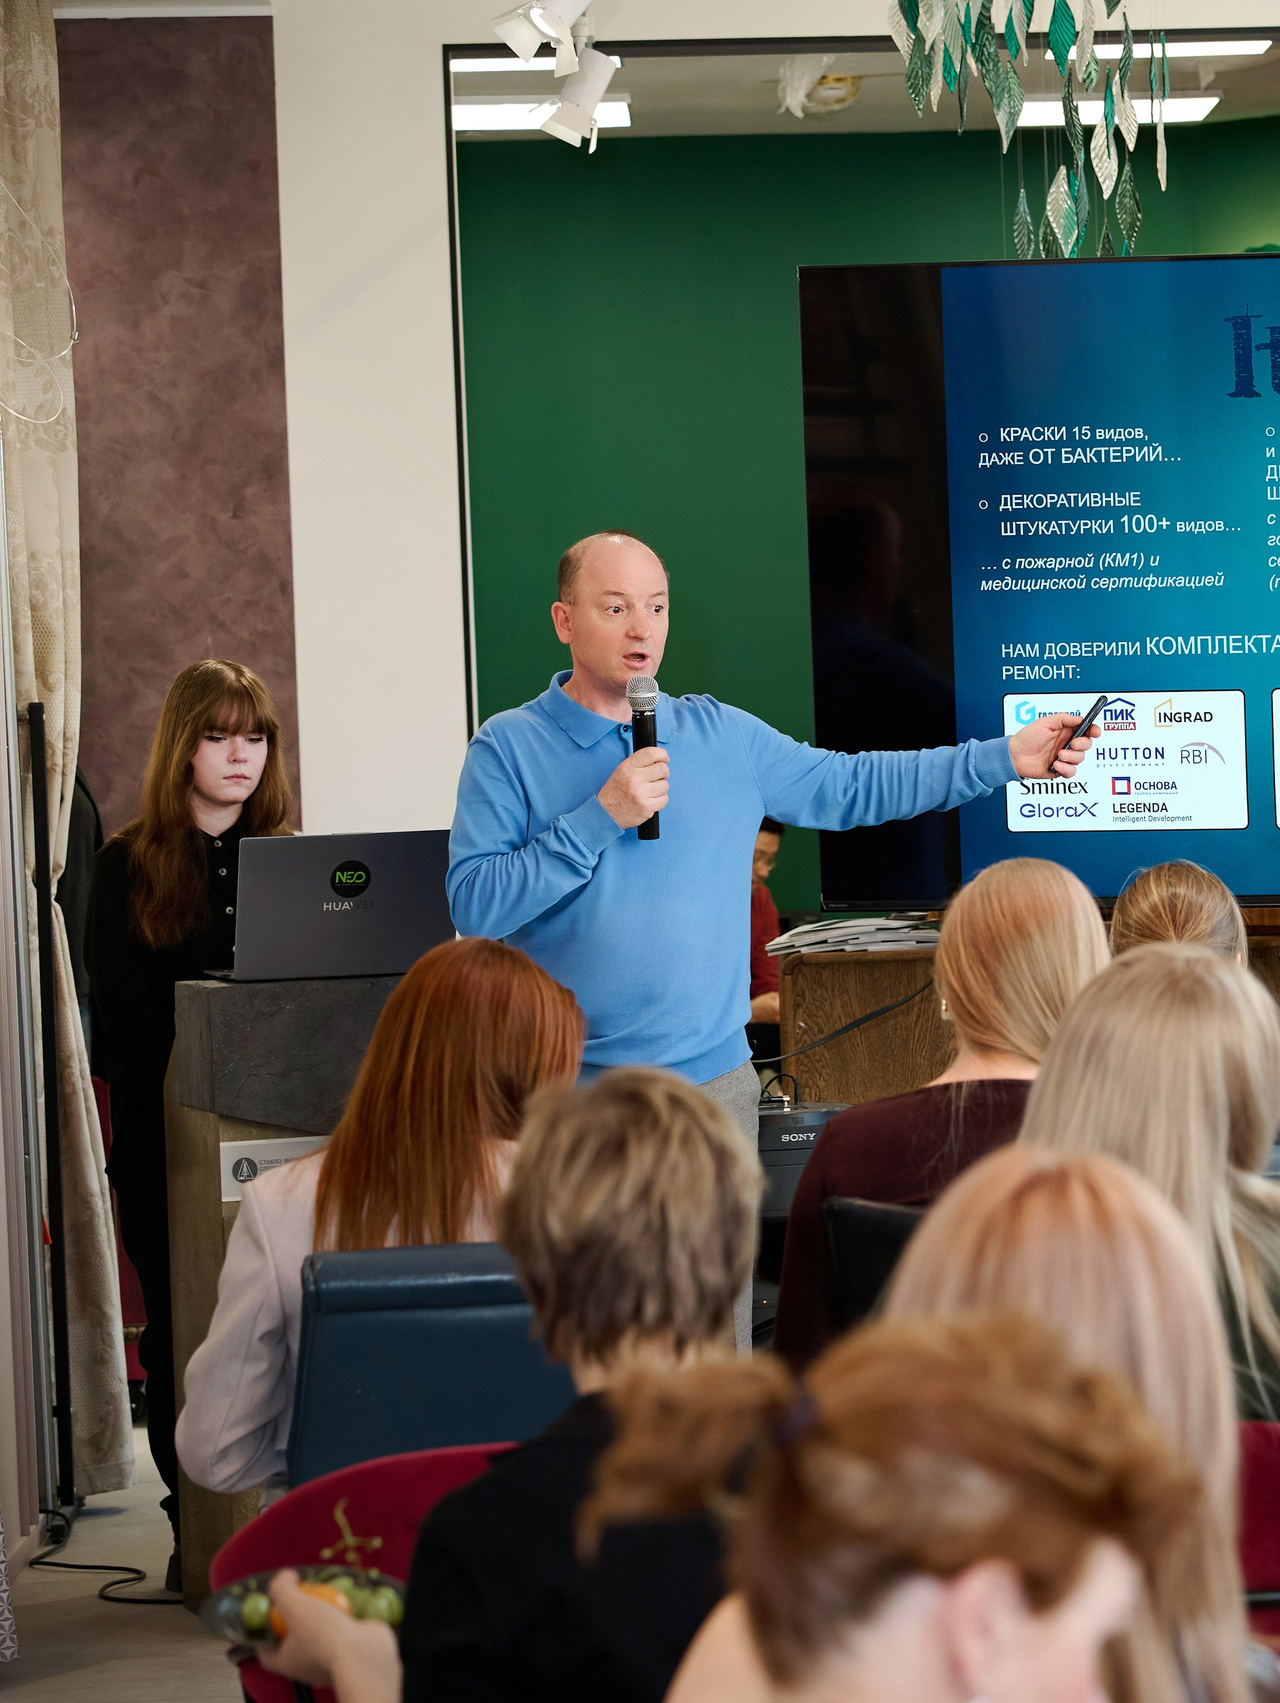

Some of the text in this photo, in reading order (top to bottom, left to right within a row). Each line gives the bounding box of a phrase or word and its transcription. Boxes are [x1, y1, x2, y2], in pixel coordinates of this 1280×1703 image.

[1000, 425, 1149, 442] КРАСКИ 15 видов,
[979, 452, 1024, 468] ДАЖЕ
[1029, 448, 1055, 465] ОТ
[1265, 447, 1275, 458] и
[999, 492, 1141, 512] ДЕКОРАТИВНЫЕ
[1001, 519, 1114, 536] ШТУКАТУРКИ
[1120, 514, 1171, 533] 100+
[1267, 514, 1276, 524] с
[1002, 559, 1011, 570] с
[1015, 554, 1094, 572] пожарной
[1099, 553, 1144, 571] (КМ1)
[1149, 555, 1160, 567] и
[980, 572, 1224, 591] медицинской сертификацией
[1001, 643, 1040, 658] НАМ
[1044, 641, 1141, 660] ДОВЕРИЛИ
[1002, 664, 1081, 681] РЕМОНТ:
[1103, 708, 1135, 721] ПИК
[1158, 711, 1213, 723] INGRAD
[1104, 722, 1135, 730] ГРУППА
[1096, 747, 1165, 760] HUTTON
[1180, 749, 1208, 764] RBI
[1020, 778, 1088, 795] Sminex
[1134, 781, 1178, 791] ОСНОВА
[1019, 802, 1099, 818] GloraX
[1112, 803, 1169, 813] LEGENDA
[1112, 815, 1193, 824] Intelligent Development
[781, 1133, 816, 1142] SONY
